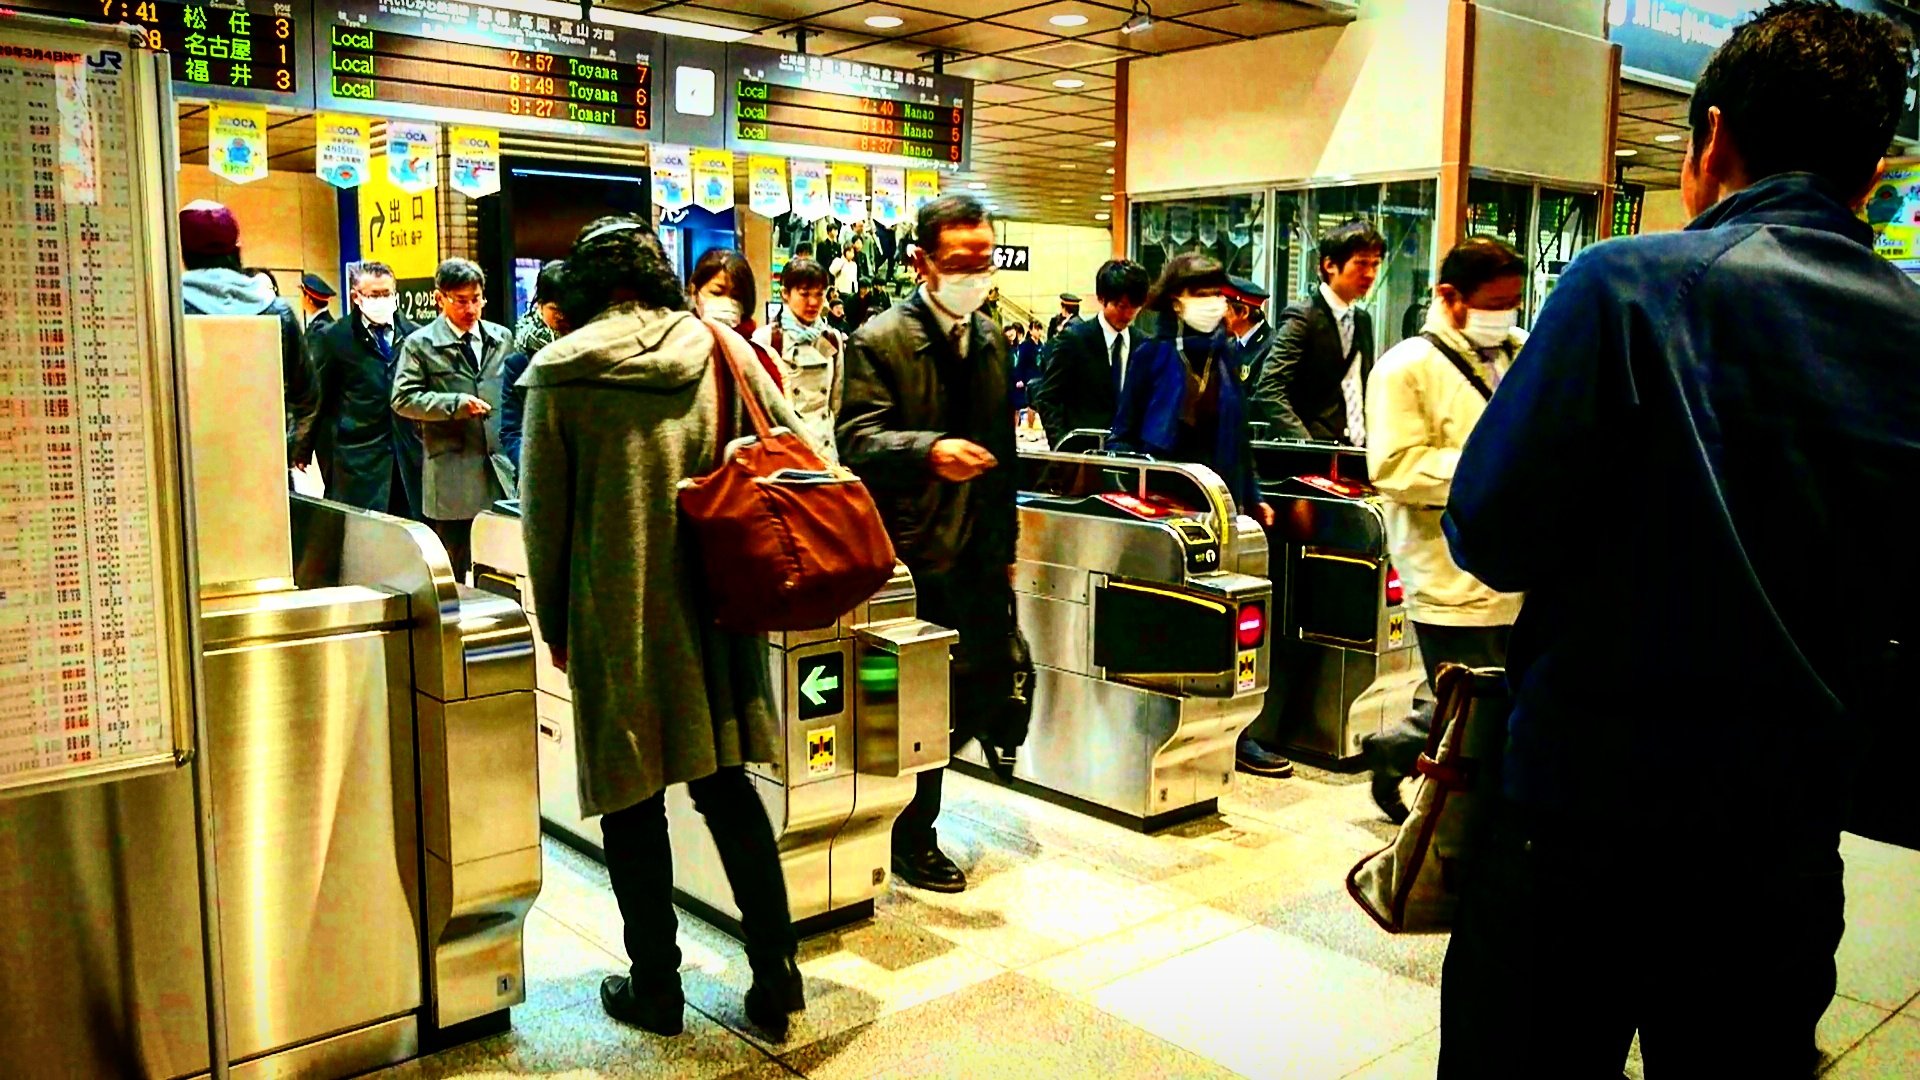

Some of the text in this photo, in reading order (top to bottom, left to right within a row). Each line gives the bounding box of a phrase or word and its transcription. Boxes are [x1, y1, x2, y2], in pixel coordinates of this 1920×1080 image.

[100, 0, 290, 39] 7:41 松任 3
[87, 50, 123, 70] JR
[184, 33, 252, 62] 名古屋
[278, 45, 287, 65] 1
[332, 26, 373, 49] Local
[510, 50, 554, 71] 7:57
[568, 58, 618, 82] Toyama
[636, 66, 648, 84] 7
[185, 57, 291, 90] 福井 3
[332, 51, 647, 106] Local 8:49 Toyama 6
[332, 76, 647, 128] Local 9:27 Tomari 5
[737, 80, 768, 99] Local
[862, 97, 894, 116] 7:40
[904, 103, 935, 121] Nanao
[737, 100, 768, 119] Local
[904, 123, 935, 140] Nanao
[951, 126, 961, 142] 5
[737, 120, 961, 161] Local 8:37 Nanao 5
[389, 195, 424, 224] 出口
[390, 228, 407, 248] Exit
